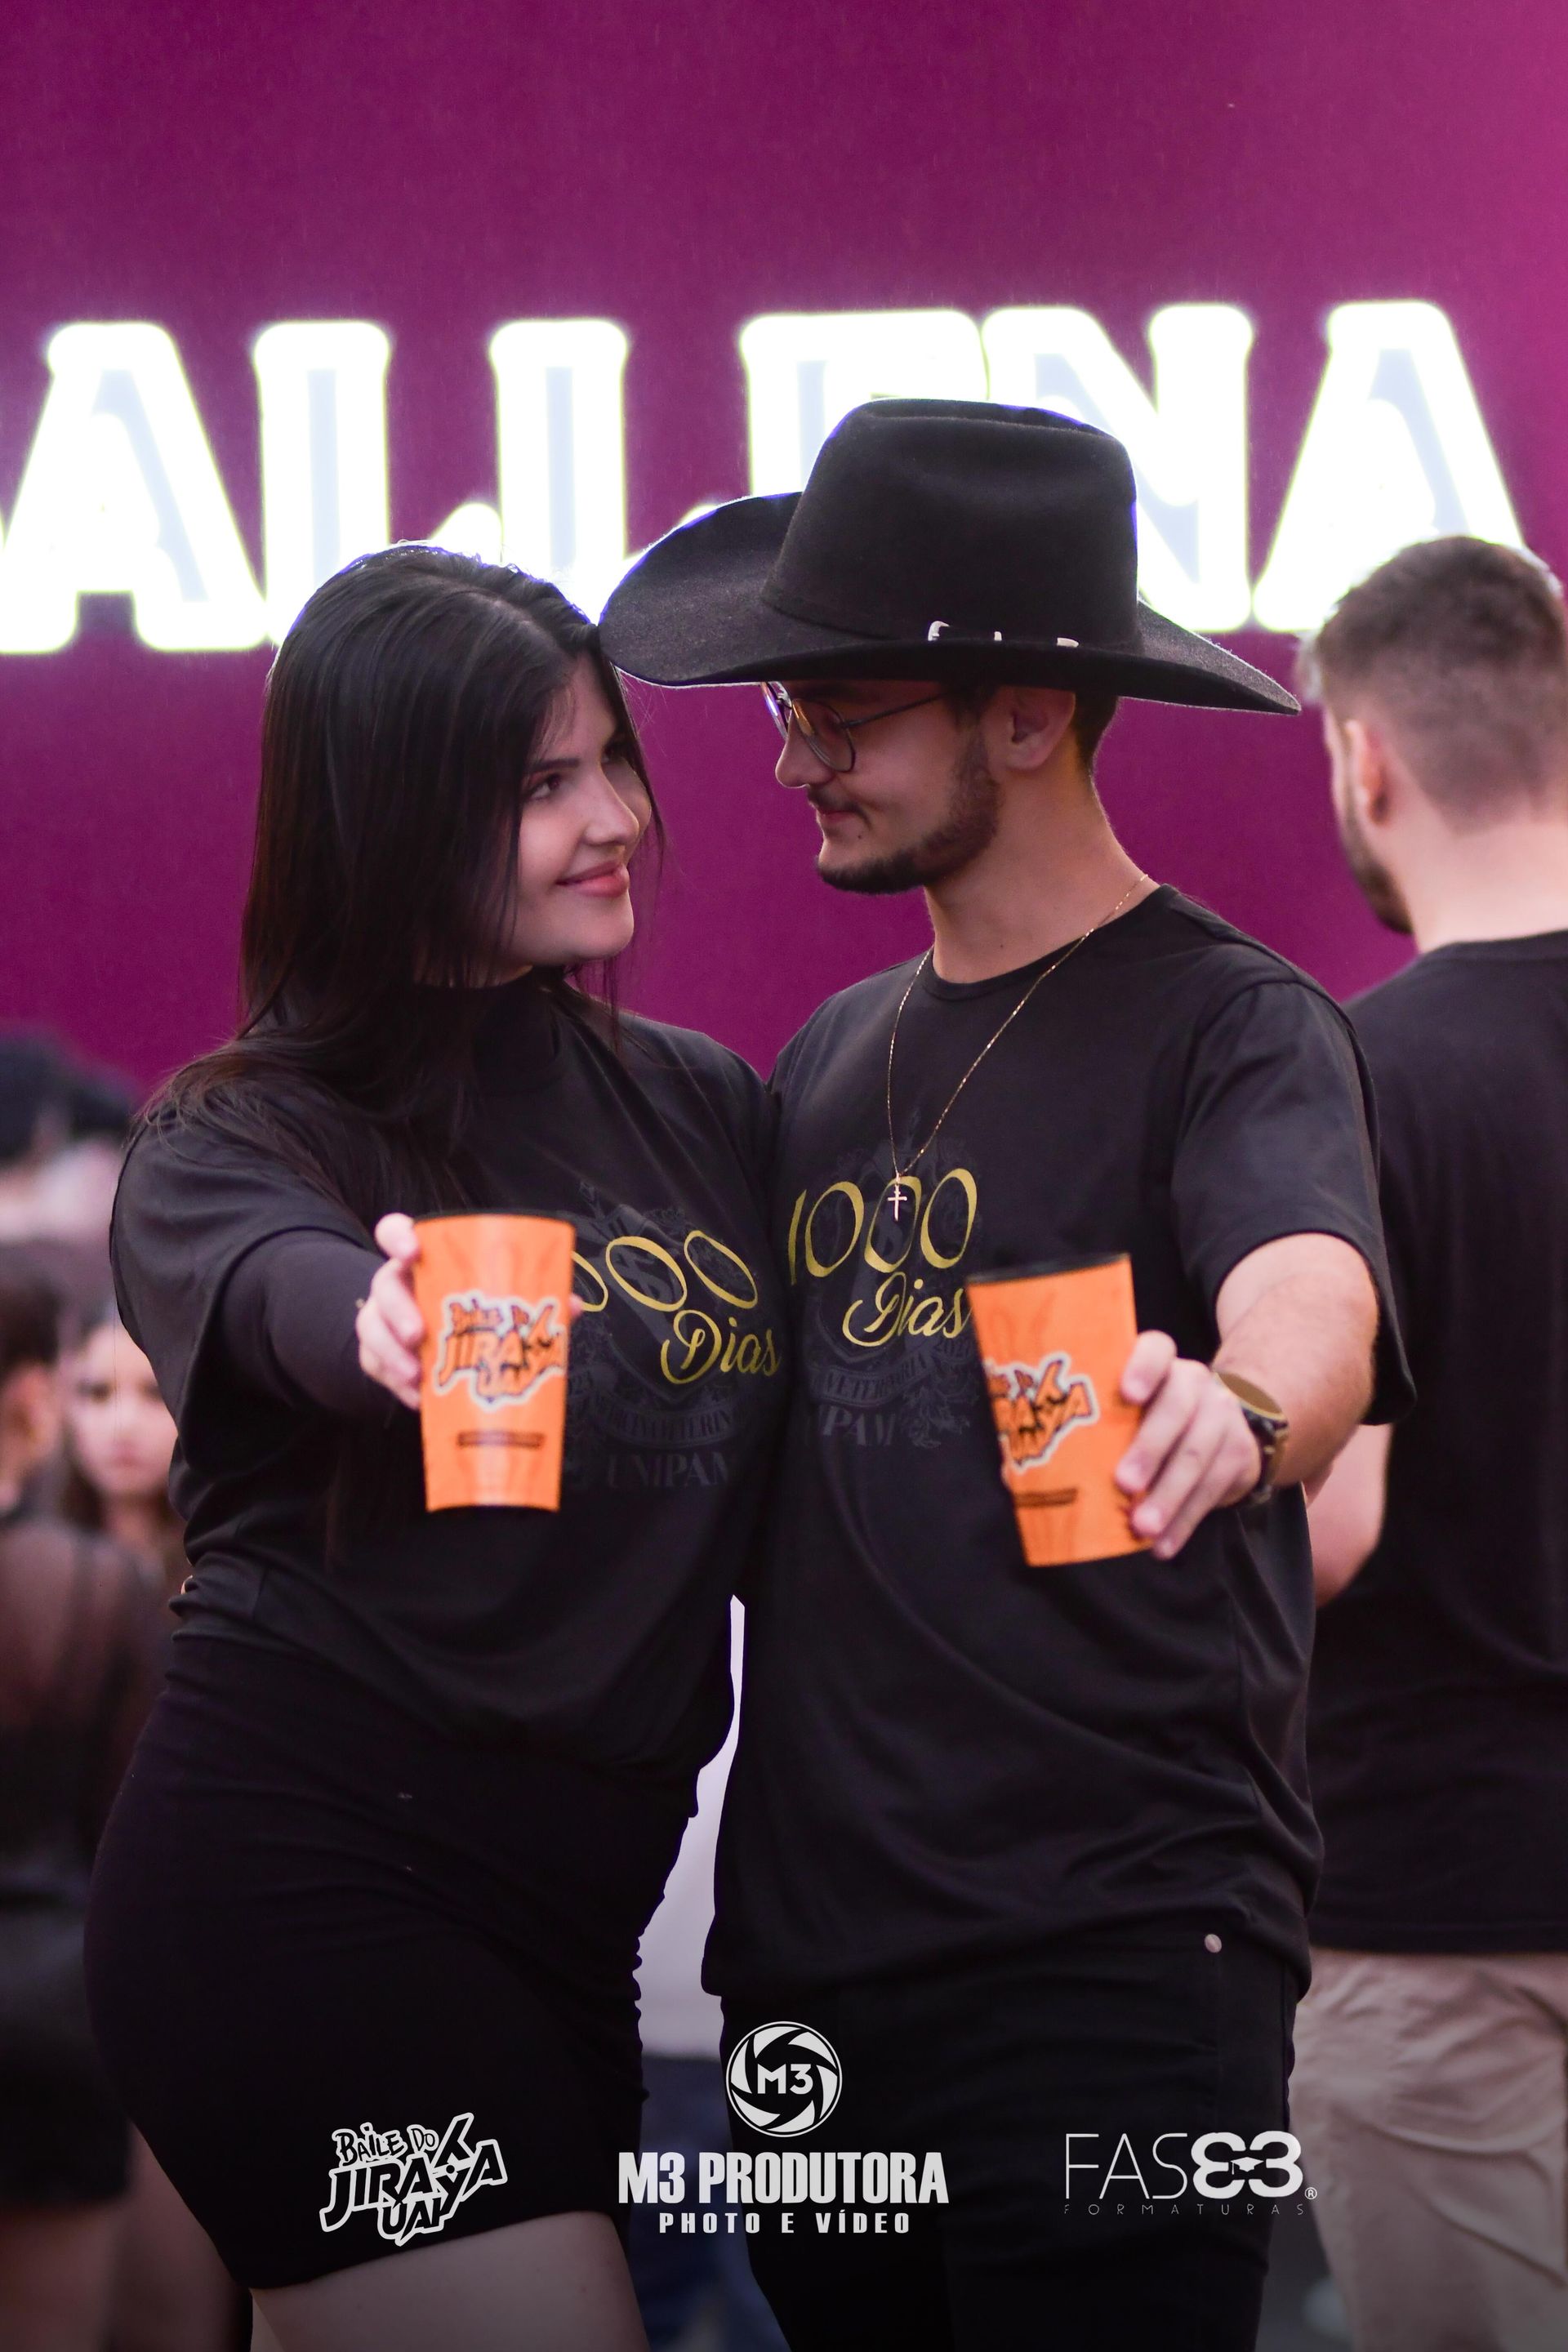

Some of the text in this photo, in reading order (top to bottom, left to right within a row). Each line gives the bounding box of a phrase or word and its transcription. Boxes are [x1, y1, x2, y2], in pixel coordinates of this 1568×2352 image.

[788, 1169, 978, 1285] 1000
[660, 1308, 782, 1384] Dias
[841, 1272, 971, 1348] Dias
